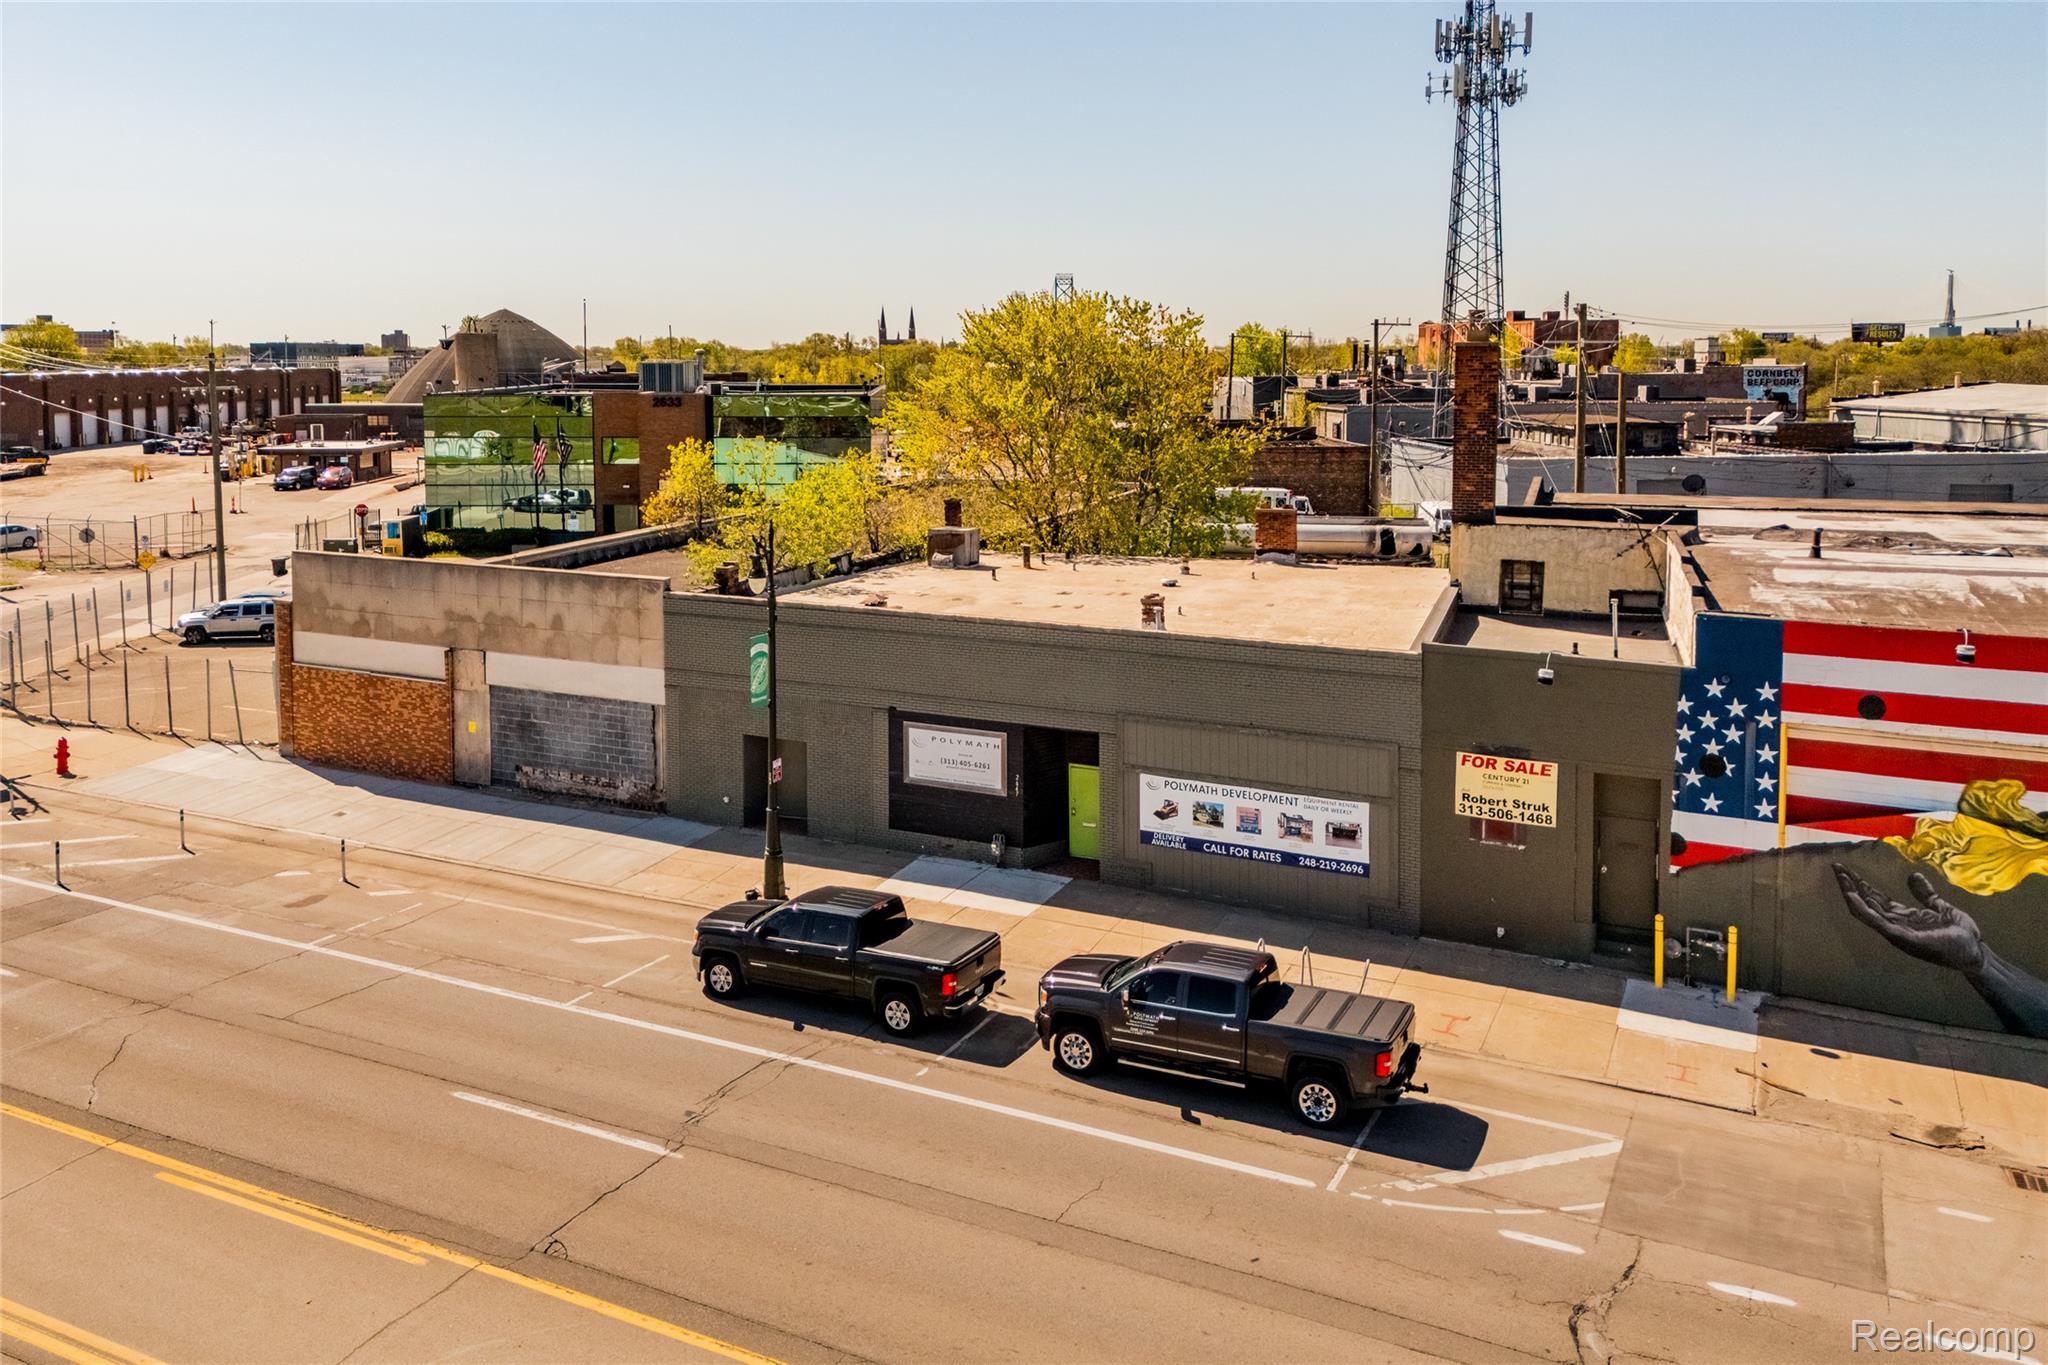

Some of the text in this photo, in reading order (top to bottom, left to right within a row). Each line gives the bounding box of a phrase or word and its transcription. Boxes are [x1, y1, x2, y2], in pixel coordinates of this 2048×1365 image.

[1747, 369, 1800, 378] CORNBELT
[931, 735, 1000, 750] POLYMATH
[940, 757, 958, 767] (313)
[959, 760, 991, 770] 405-6261
[1461, 754, 1553, 777] FOR SALE
[1482, 773, 1520, 784] CENTURY
[1164, 780, 1299, 807] POLYMATH DEVELOPMENT
[1303, 797, 1337, 806] EQUIPMENT
[1303, 804, 1319, 812] DAILY
[1461, 792, 1550, 813] Robert Struk
[1458, 803, 1553, 826] 313-506-1468
[1151, 839, 1187, 850] AVAILABLE
[1153, 832, 1185, 843] DELIVERY
[1203, 843, 1282, 863] CALL FOR RATES
[1298, 856, 1365, 875] 248-219-2696
